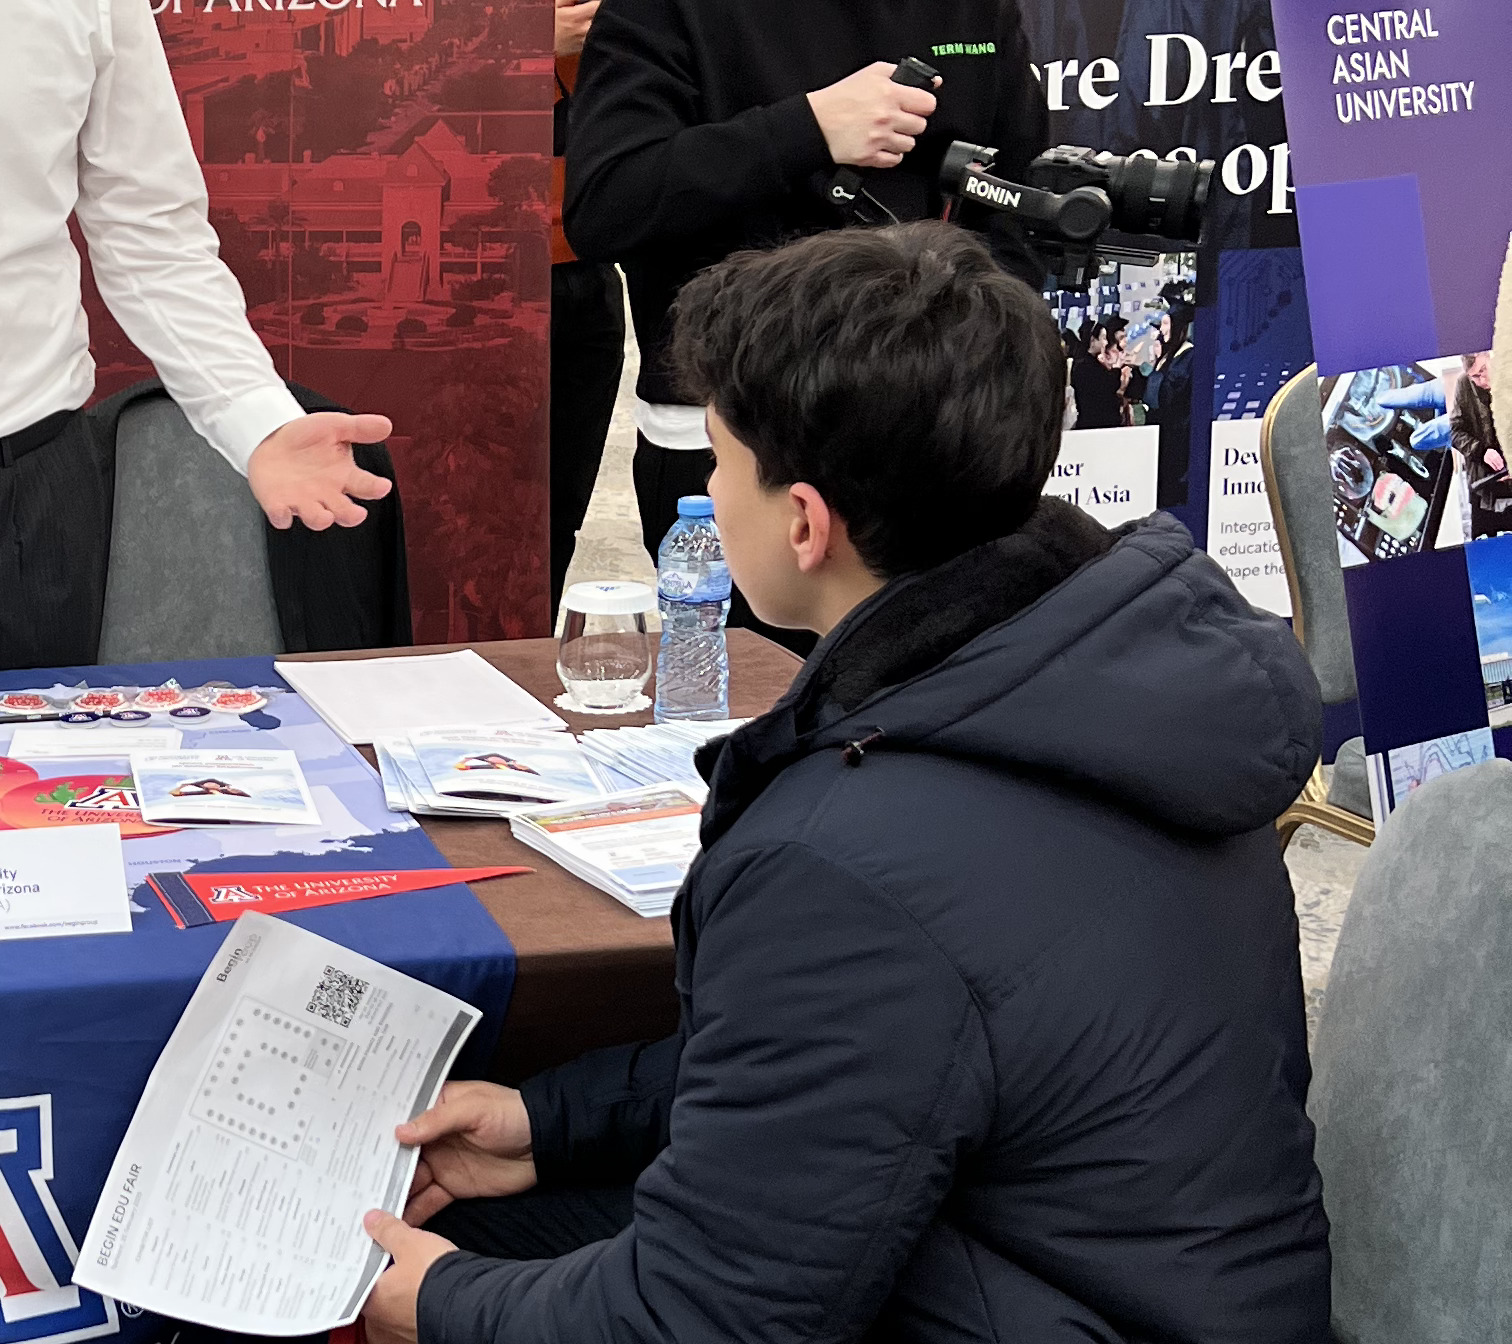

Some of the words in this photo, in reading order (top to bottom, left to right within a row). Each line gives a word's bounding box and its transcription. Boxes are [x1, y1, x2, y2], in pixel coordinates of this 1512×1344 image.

[1327, 8, 1439, 45] CENTRAL
[1029, 57, 1120, 111] re
[1143, 33, 1284, 108] Dre
[1333, 48, 1410, 85] ASIAN
[1335, 81, 1475, 124] UNIVERSITY
[1221, 142, 1296, 215] op
[965, 175, 1023, 209] RONIN
[1223, 447, 1260, 466] Dev
[1085, 485, 1131, 506] Asia
[1222, 477, 1267, 495] Inno
[1220, 520, 1275, 537] Integra
[1219, 541, 1280, 556] educatio
[1225, 564, 1261, 581] hape
[40, 808, 68, 816] THE
[74, 810, 141, 818] UNIVERS
[252, 884, 289, 893] THE
[294, 874, 397, 890] UNIVERSITY
[305, 883, 391, 896] ARIZONA
[216, 947, 243, 982] Begin
[96, 1225, 120, 1267] BEGIN
[111, 1194, 130, 1224] EDU
[122, 1162, 142, 1194] FAIR
